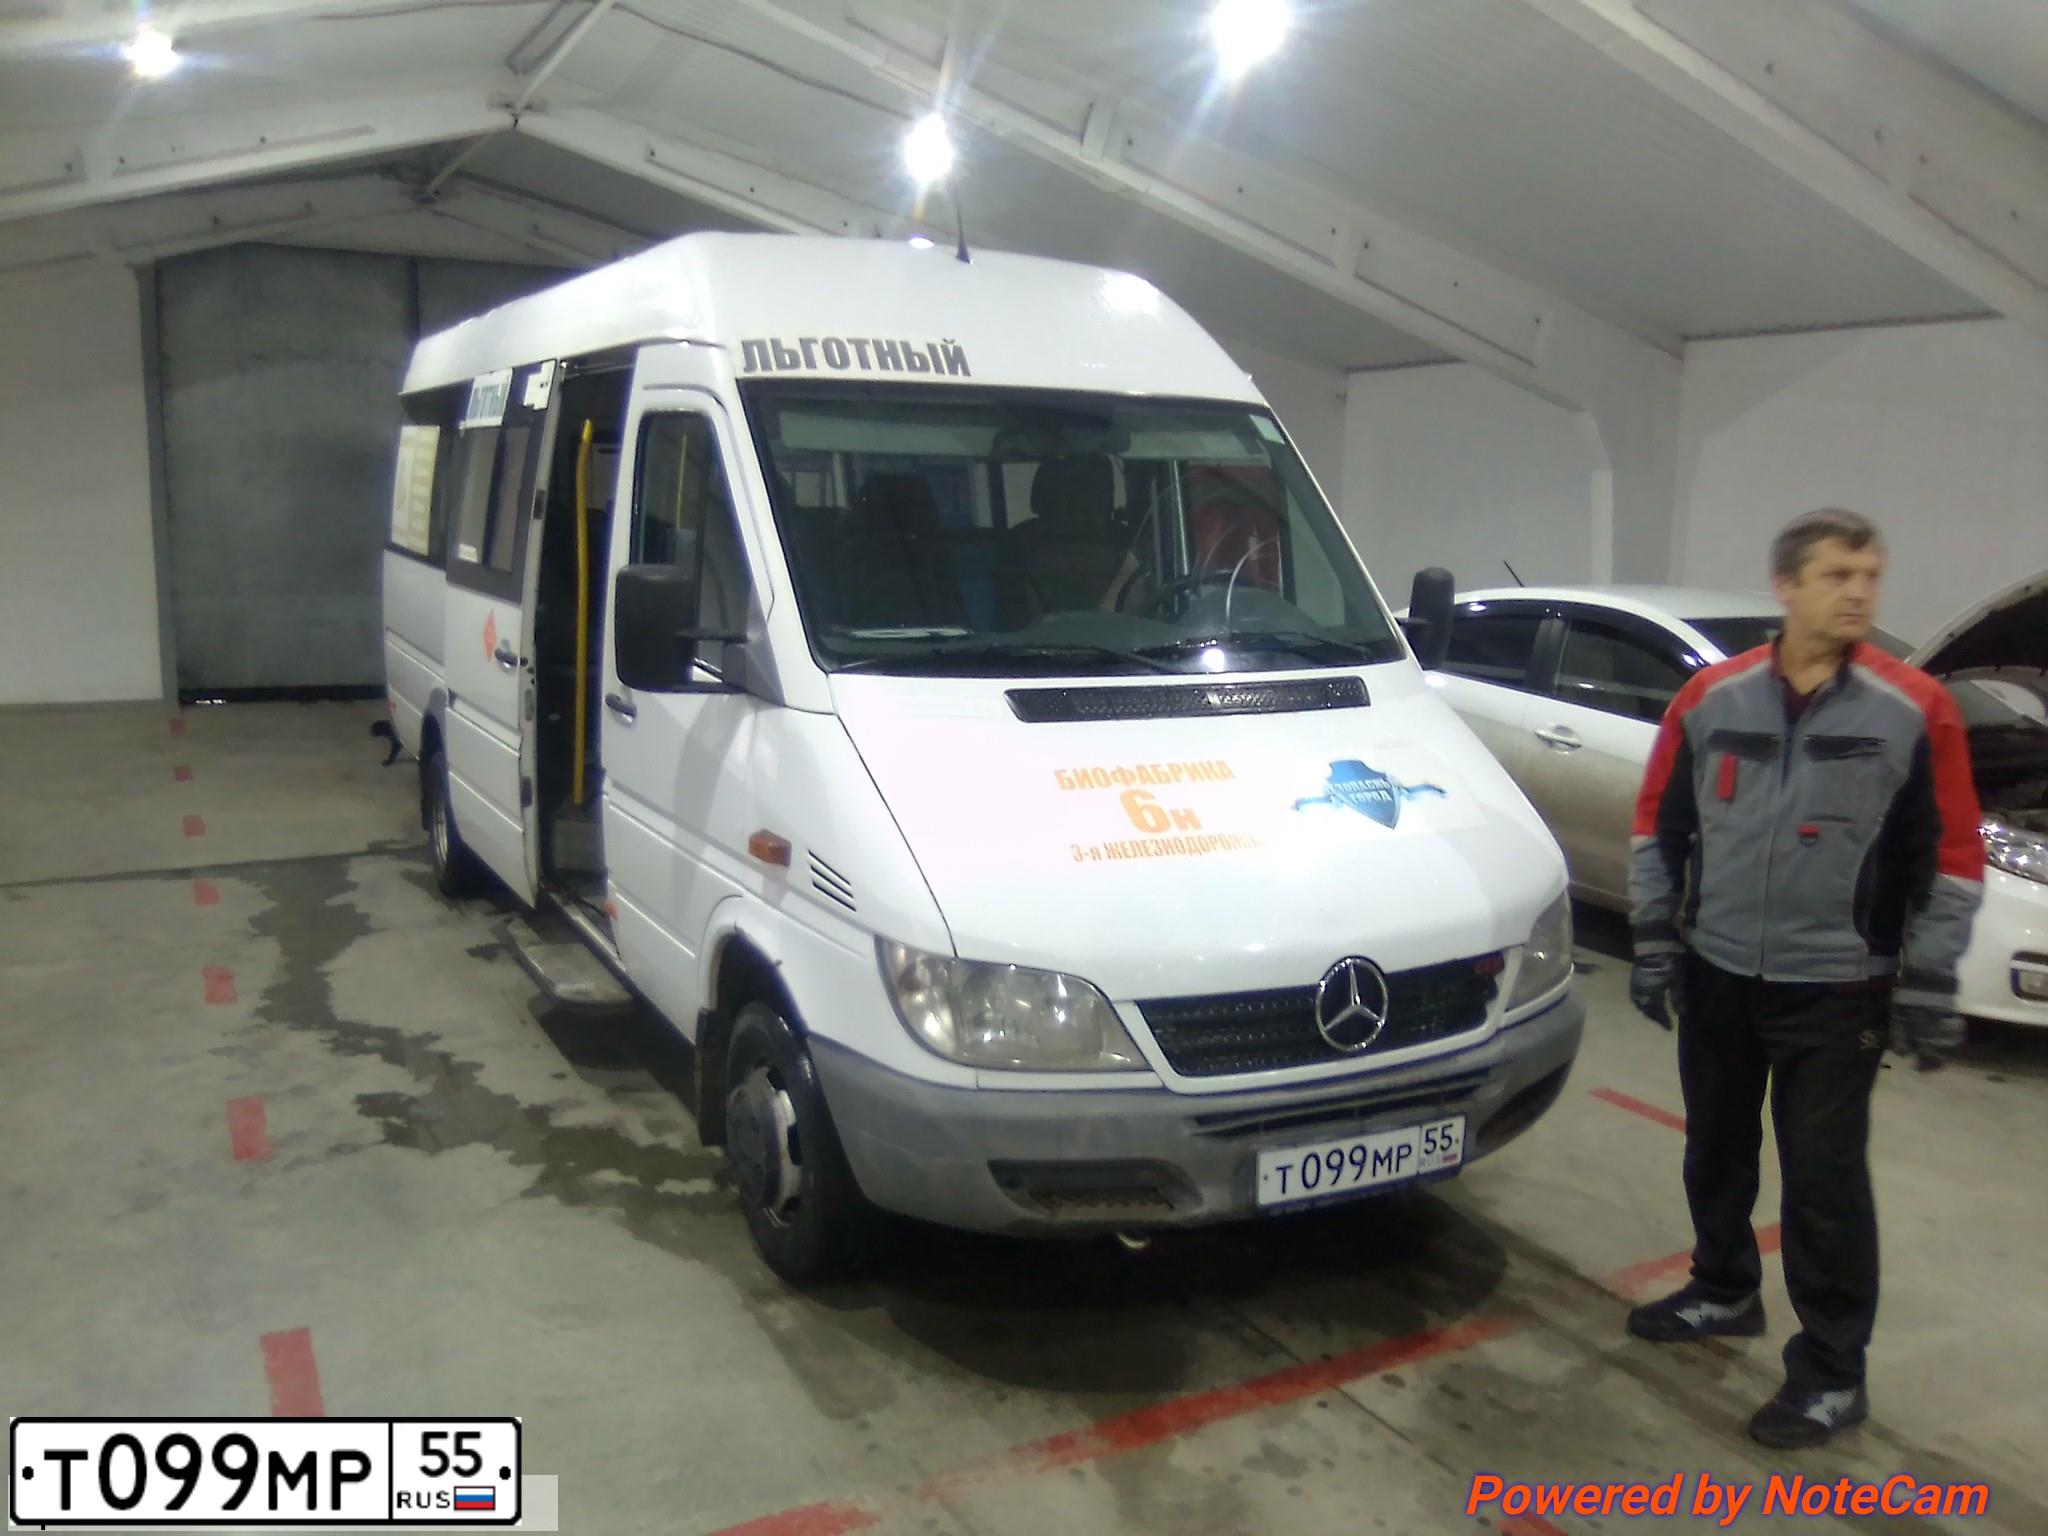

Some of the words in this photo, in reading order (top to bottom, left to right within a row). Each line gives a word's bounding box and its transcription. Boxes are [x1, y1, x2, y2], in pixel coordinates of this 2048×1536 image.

[741, 337, 972, 377] ЛЬГОТНЫЙ
[1054, 759, 1236, 791] БИОФАБРИКА
[1070, 842, 1102, 863] 3-я
[1275, 1142, 1412, 1195] Т099МР
[1423, 1124, 1454, 1155] 55
